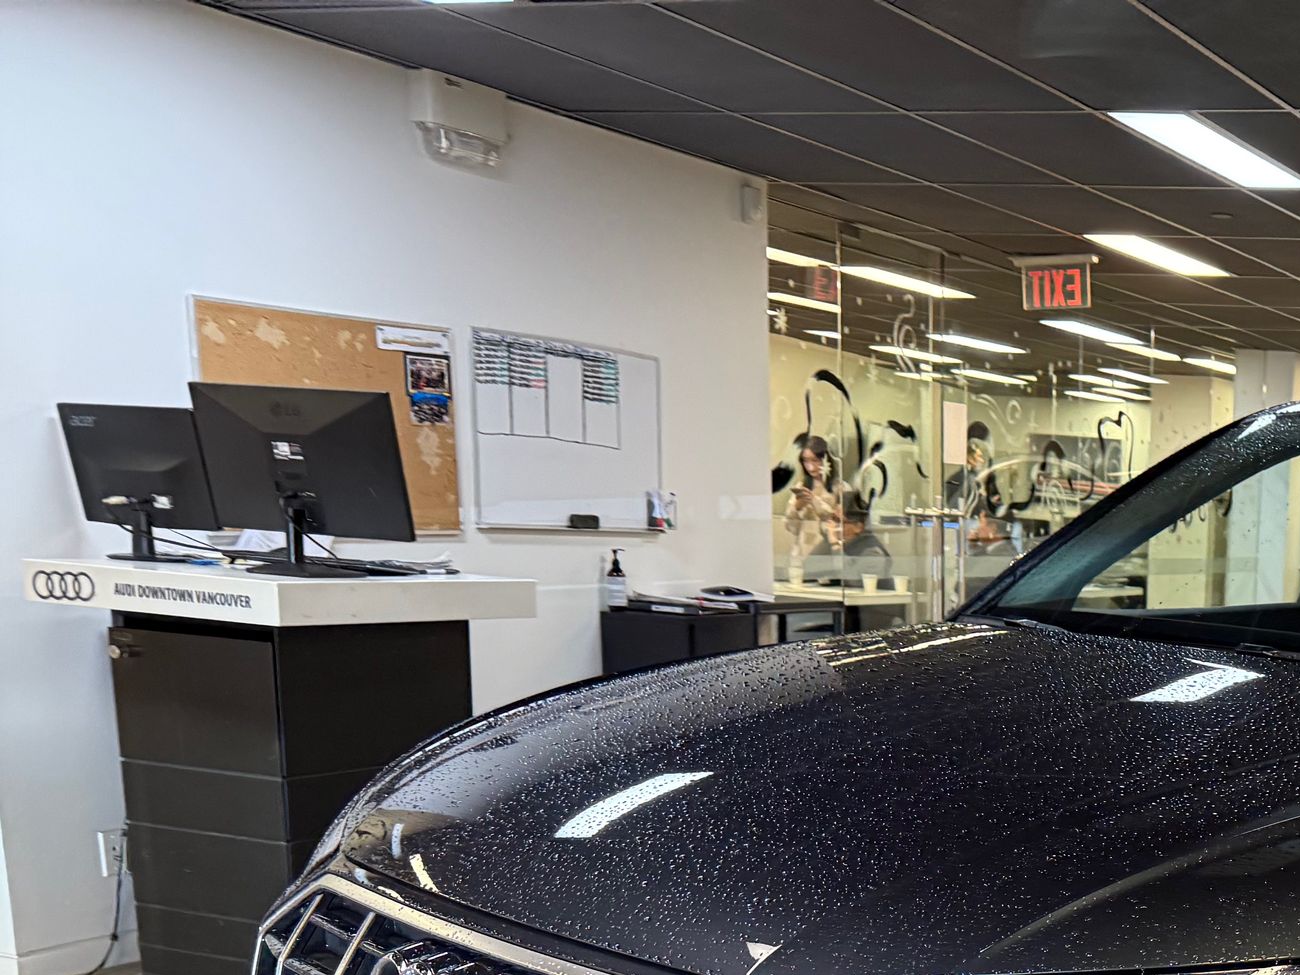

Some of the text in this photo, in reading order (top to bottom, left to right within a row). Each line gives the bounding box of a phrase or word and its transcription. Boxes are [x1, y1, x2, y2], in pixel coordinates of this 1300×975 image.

[114, 582, 252, 609] AUDI DOWNTOWN VANCOUVER
